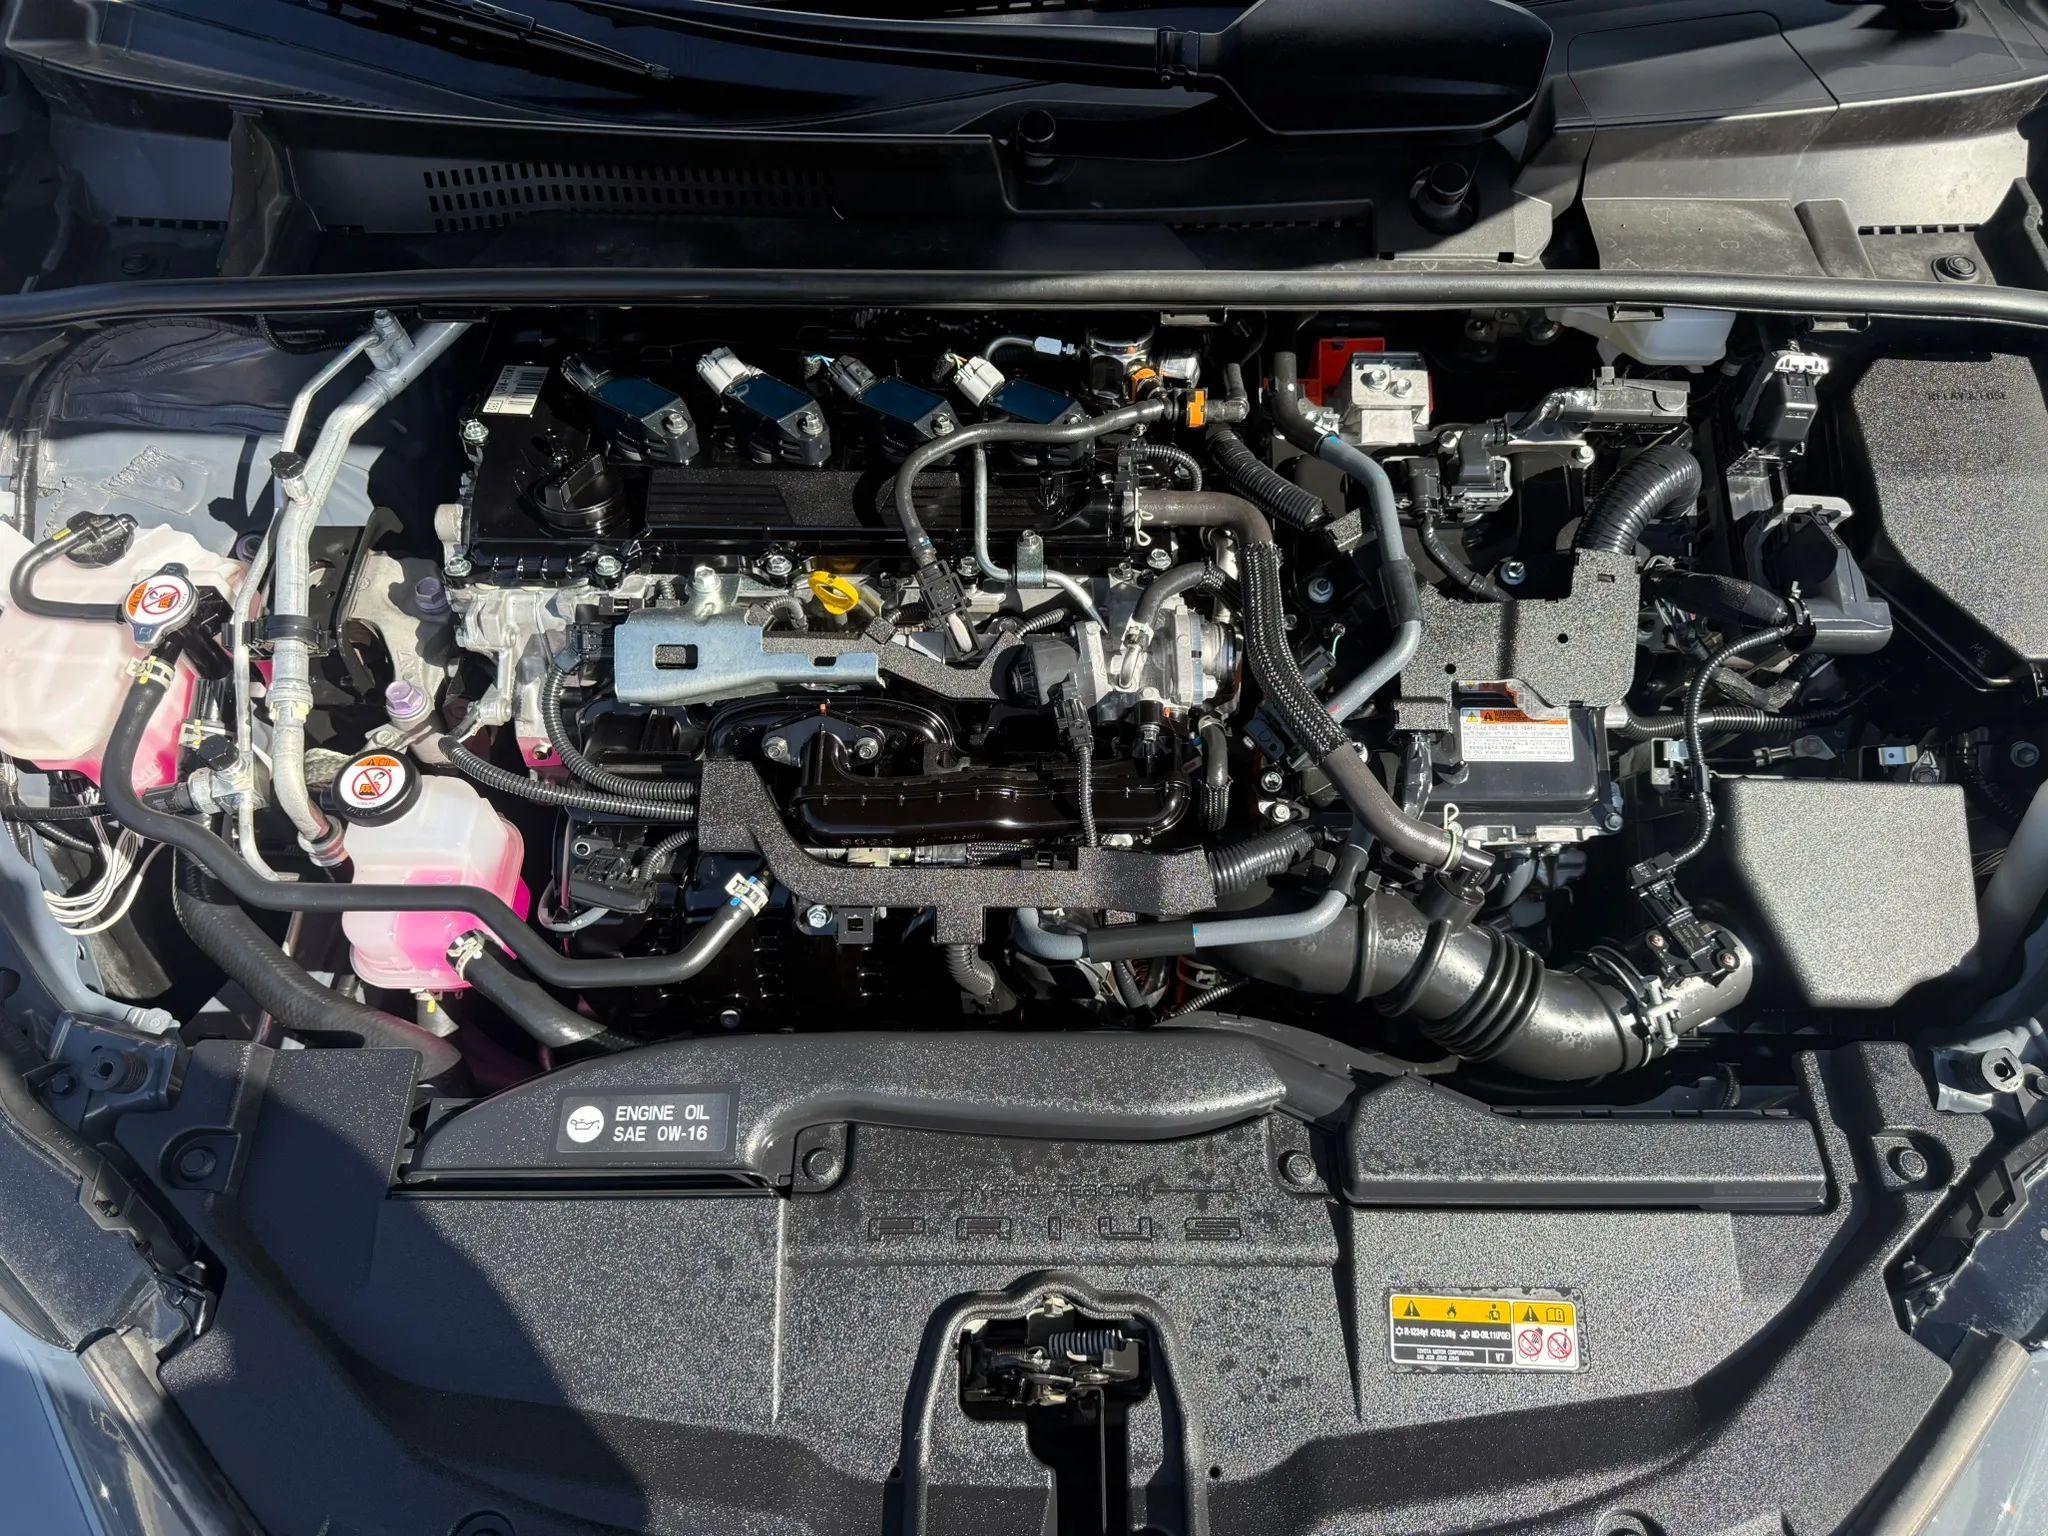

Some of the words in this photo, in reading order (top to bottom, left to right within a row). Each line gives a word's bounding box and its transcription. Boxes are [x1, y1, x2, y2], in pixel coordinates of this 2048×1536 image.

[615, 1105, 675, 1122] ENGINE
[684, 1104, 710, 1120] OIL
[612, 1126, 647, 1142] SAE
[657, 1125, 708, 1142] 0W-16
[959, 1183, 1041, 1198] HYBRID
[867, 1216, 1242, 1241] PRIUS
[1448, 1349, 1475, 1357] CORPORATION
